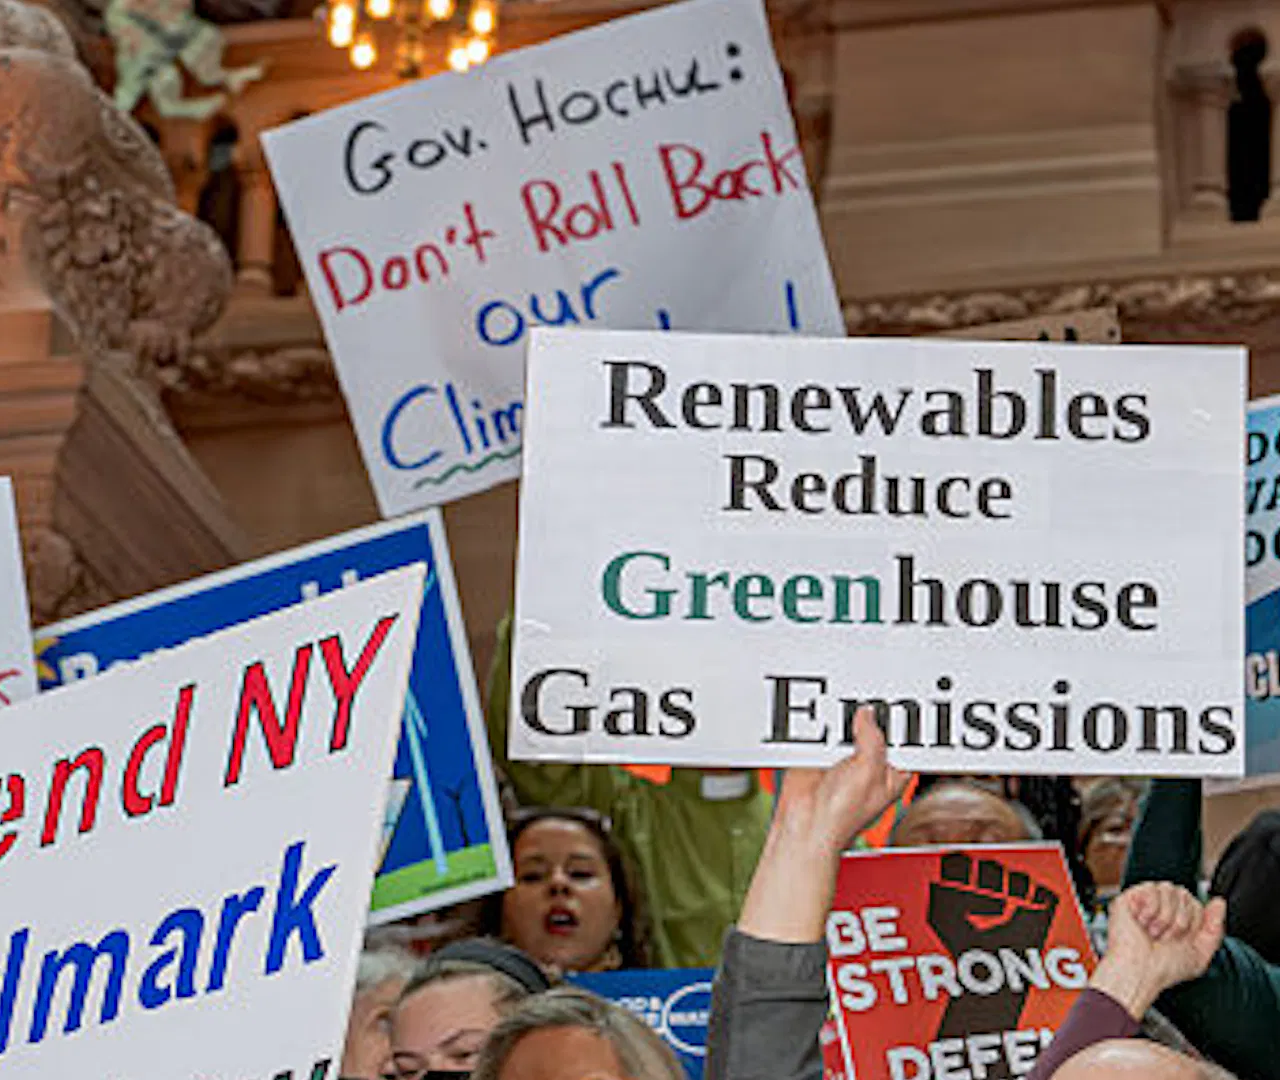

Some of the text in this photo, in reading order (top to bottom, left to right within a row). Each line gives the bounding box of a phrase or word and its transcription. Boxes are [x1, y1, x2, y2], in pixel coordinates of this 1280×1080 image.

[318, 130, 801, 314] Don't Roll Back
[476, 267, 624, 347] our
[598, 358, 1152, 443] Renewables
[721, 453, 1014, 520] Reduce
[601, 549, 1160, 632] Greenhouse
[223, 612, 402, 790] NY
[518, 667, 1239, 756] Gas Emissions
[825, 905, 909, 958] BE
[837, 947, 1090, 1013] STRONG
